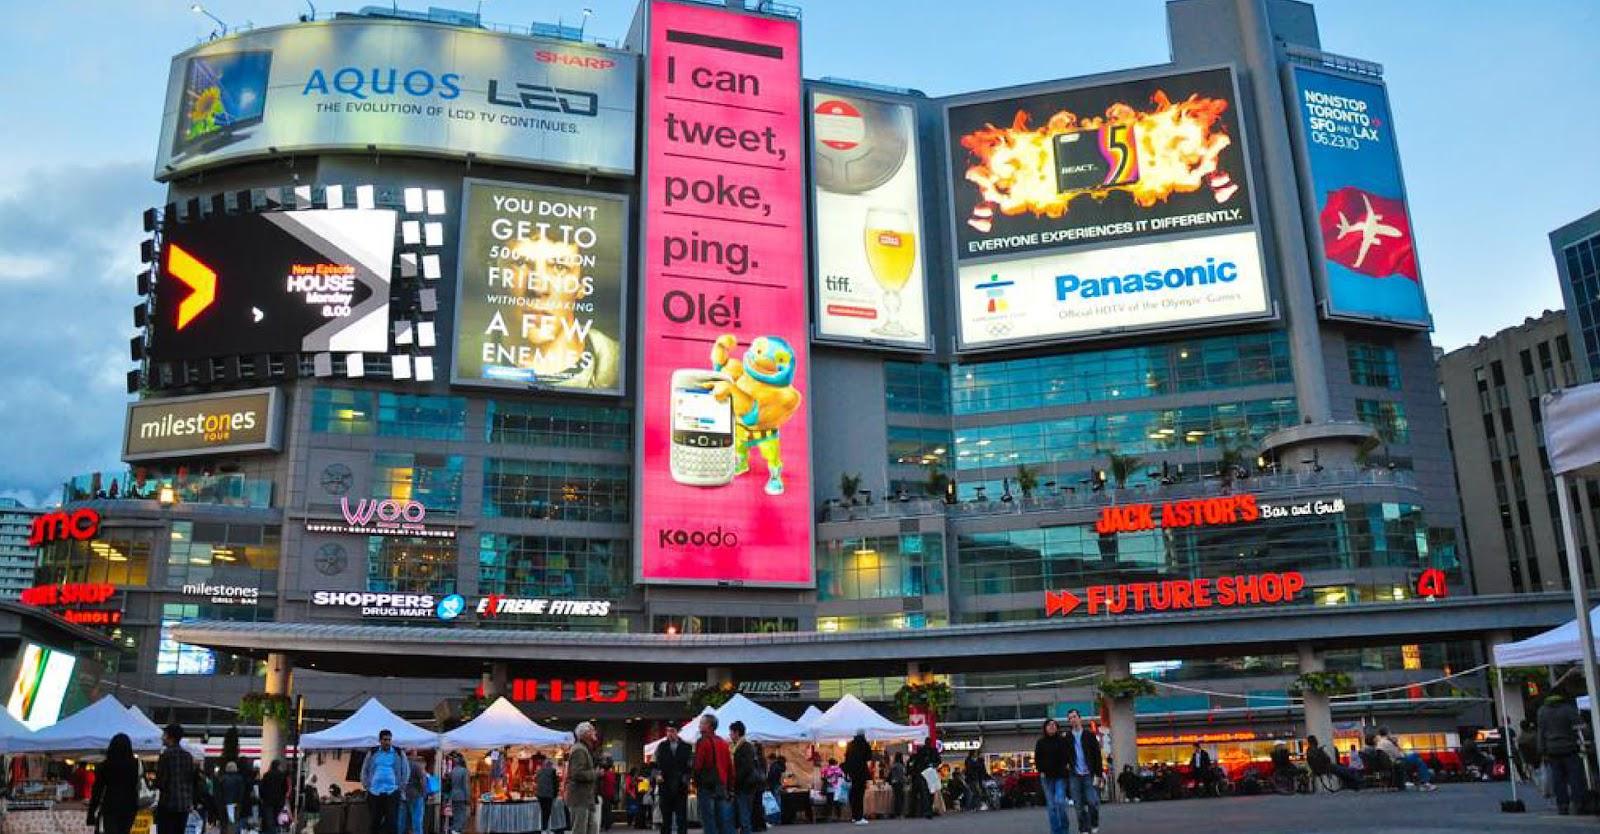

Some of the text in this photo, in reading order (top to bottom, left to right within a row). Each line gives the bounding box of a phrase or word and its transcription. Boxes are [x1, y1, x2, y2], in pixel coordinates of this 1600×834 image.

[535, 51, 616, 71] SHARP
[303, 67, 461, 99] AQUOS
[667, 56, 760, 96] I can
[488, 80, 598, 117] LED
[1304, 89, 1367, 112] NONSTOP
[316, 102, 580, 134] THE EVOLUTION OF LCD TV CONTINUES.
[1306, 104, 1370, 127] TORONTO
[1310, 117, 1336, 133] SFO
[1353, 126, 1379, 141] LAX
[664, 112, 786, 161] tweet,
[1103, 125, 1129, 186] 5
[493, 195, 598, 221] YOU DON'T
[665, 174, 771, 217] poke,
[491, 218, 597, 248] GET TO
[968, 208, 1243, 252] EVERYONE EXPERIENCES IT DIFFERENTLY.
[490, 246, 520, 260] 500
[663, 230, 759, 275] ping.
[287, 275, 354, 292] HOUSE
[293, 264, 315, 275] New
[488, 266, 594, 296] FRIENDS
[1055, 257, 1237, 301] Panasonic
[826, 275, 852, 293] tiff.
[306, 291, 352, 306] Monday
[663, 290, 742, 328] Olé!
[1095, 305, 1124, 316] HDTV
[1142, 299, 1157, 310] the
[485, 310, 593, 342] A FEW
[141, 410, 256, 438] milestones
[1096, 494, 1345, 535] JACK ASTOR'S Bar and Grill
[183, 583, 259, 597] milestones
[313, 591, 434, 608] SHOPPERS
[1086, 571, 1304, 615] FUTURE SHOP
[362, 606, 434, 617] DRUG MART
[476, 593, 610, 617] EXTREME FITNESS
[944, 740, 981, 751] WORLD
